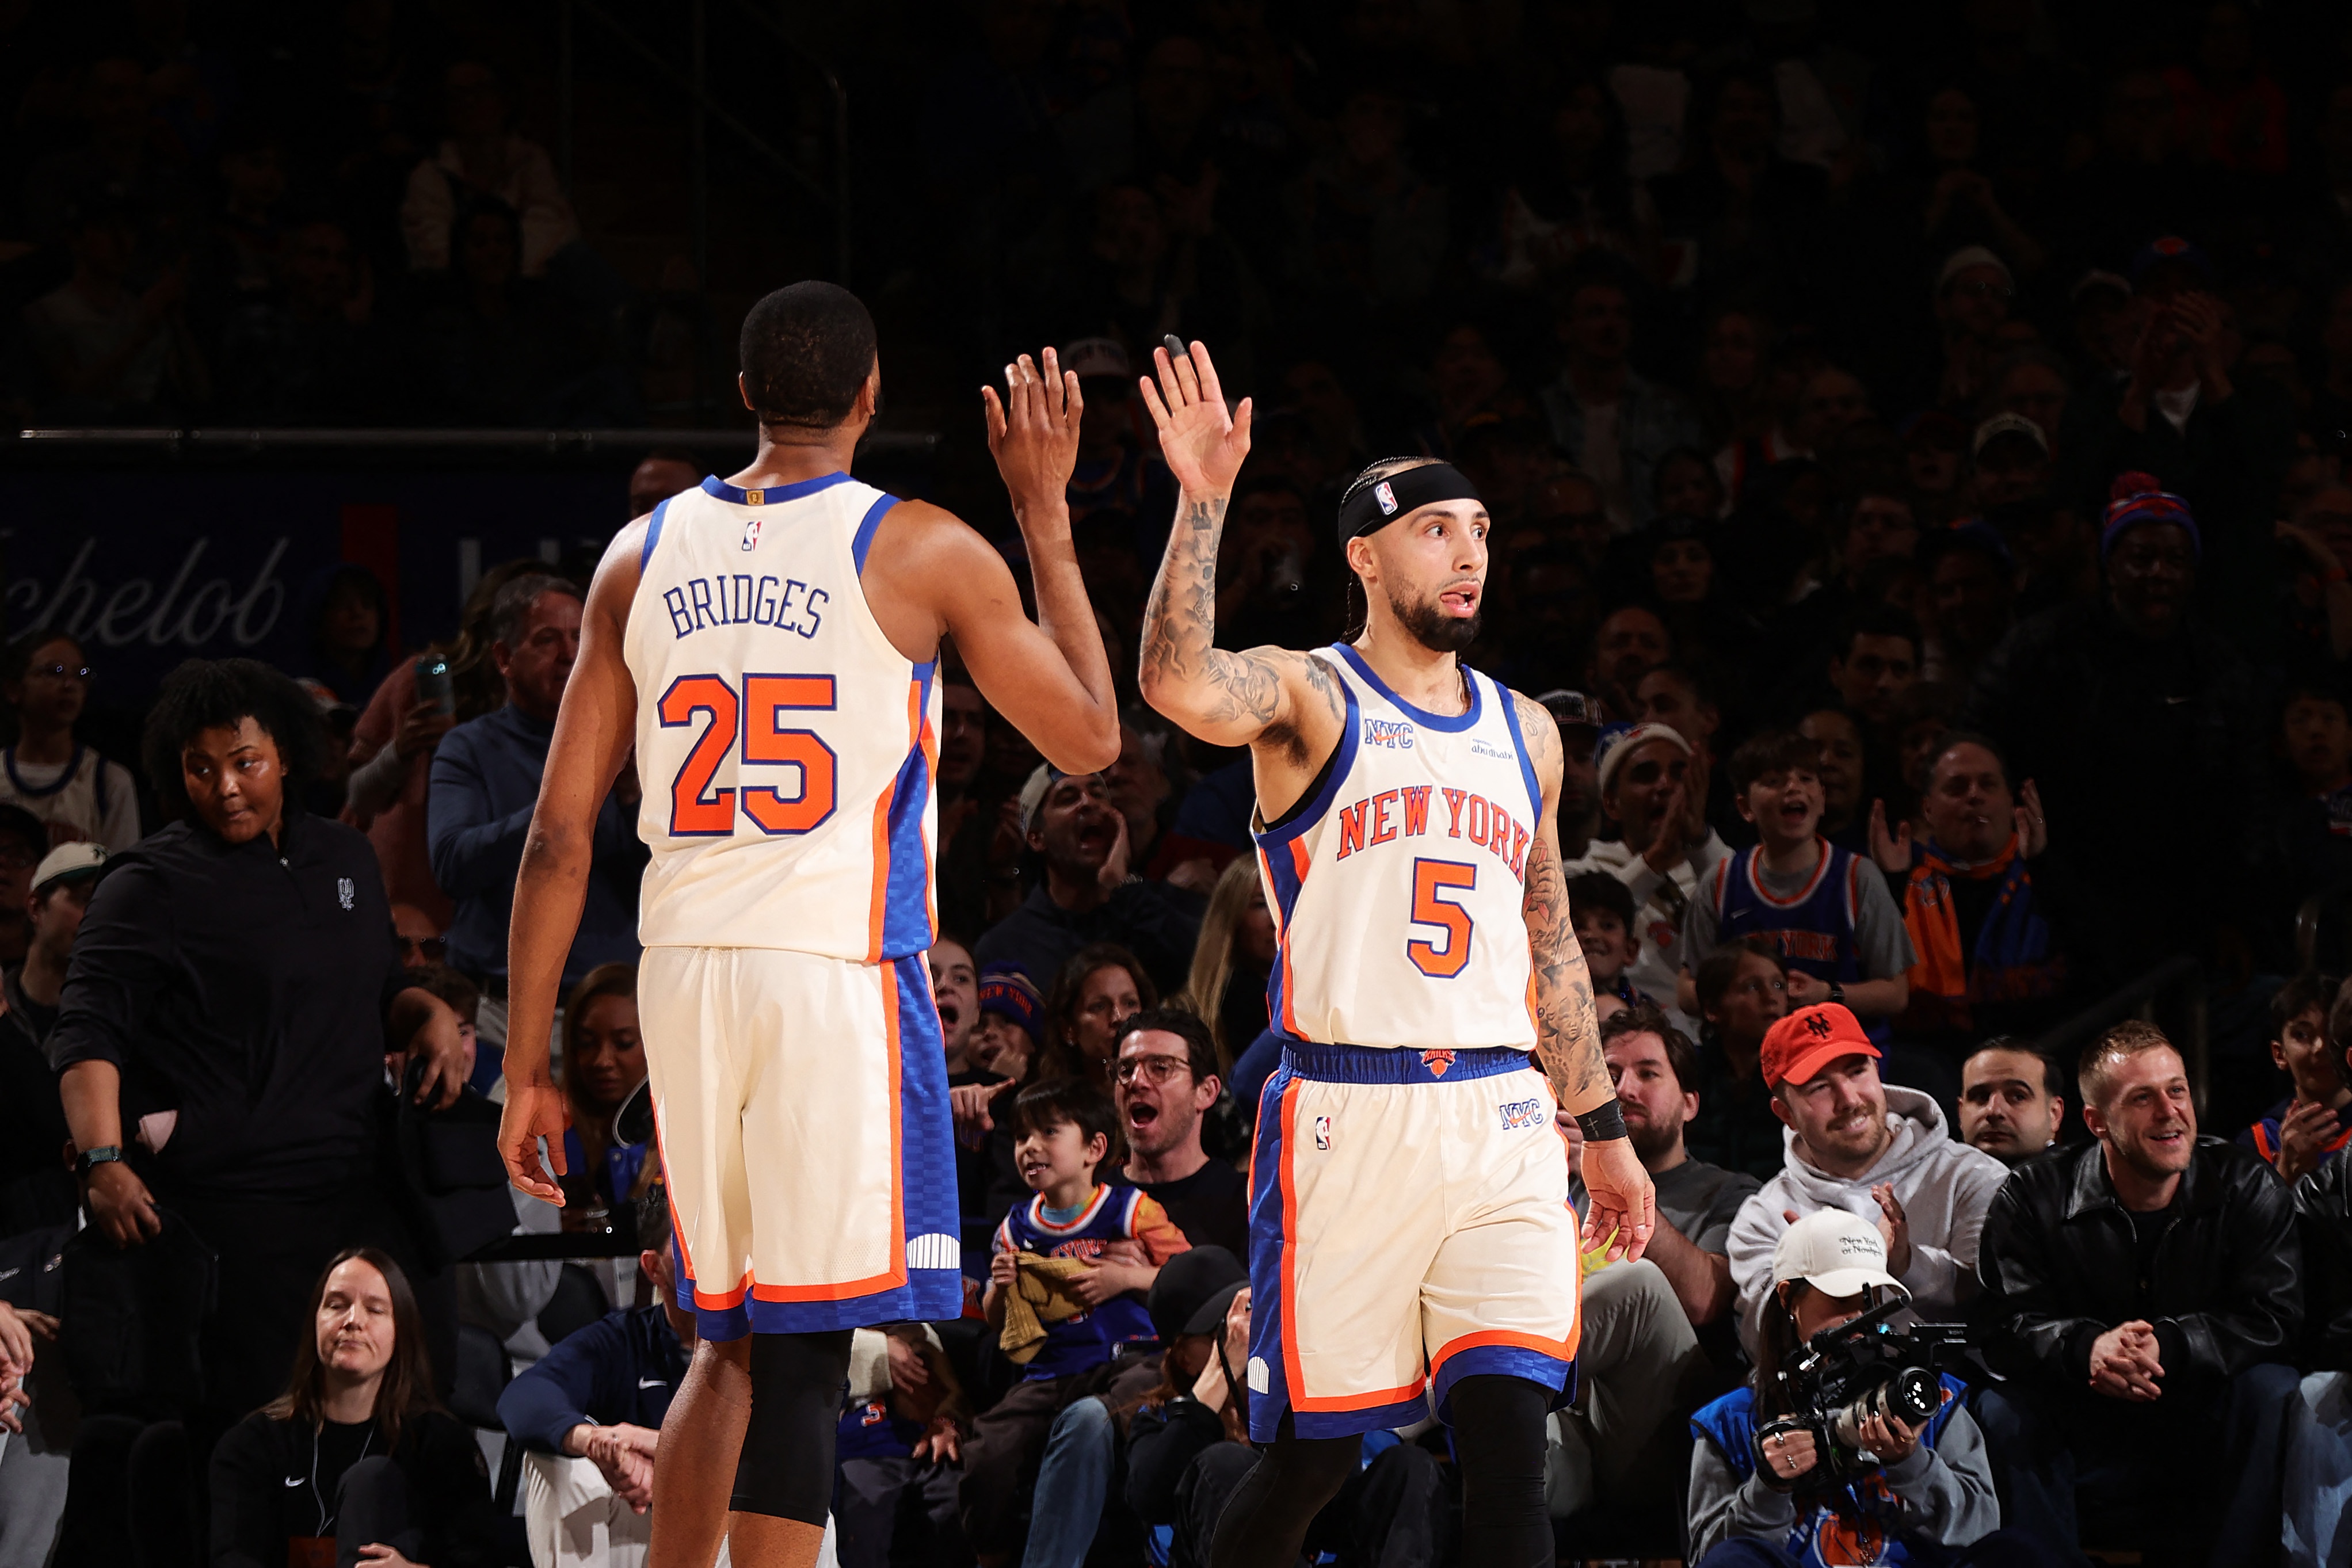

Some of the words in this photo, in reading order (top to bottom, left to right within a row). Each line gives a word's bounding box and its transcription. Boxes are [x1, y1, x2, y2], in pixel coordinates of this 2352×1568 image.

[664, 574, 829, 640] BRIDGES
[657, 673, 838, 836] 25
[1364, 718, 1413, 749] NYC
[1472, 744, 1488, 756] abu
[1488, 748, 1514, 760] dhabi
[1337, 785, 1432, 861] NEW
[1442, 787, 1530, 886] YORK
[1407, 856, 1477, 979] 5
[1782, 927, 1839, 962] YORK
[1499, 1098, 1543, 1130] NYC
